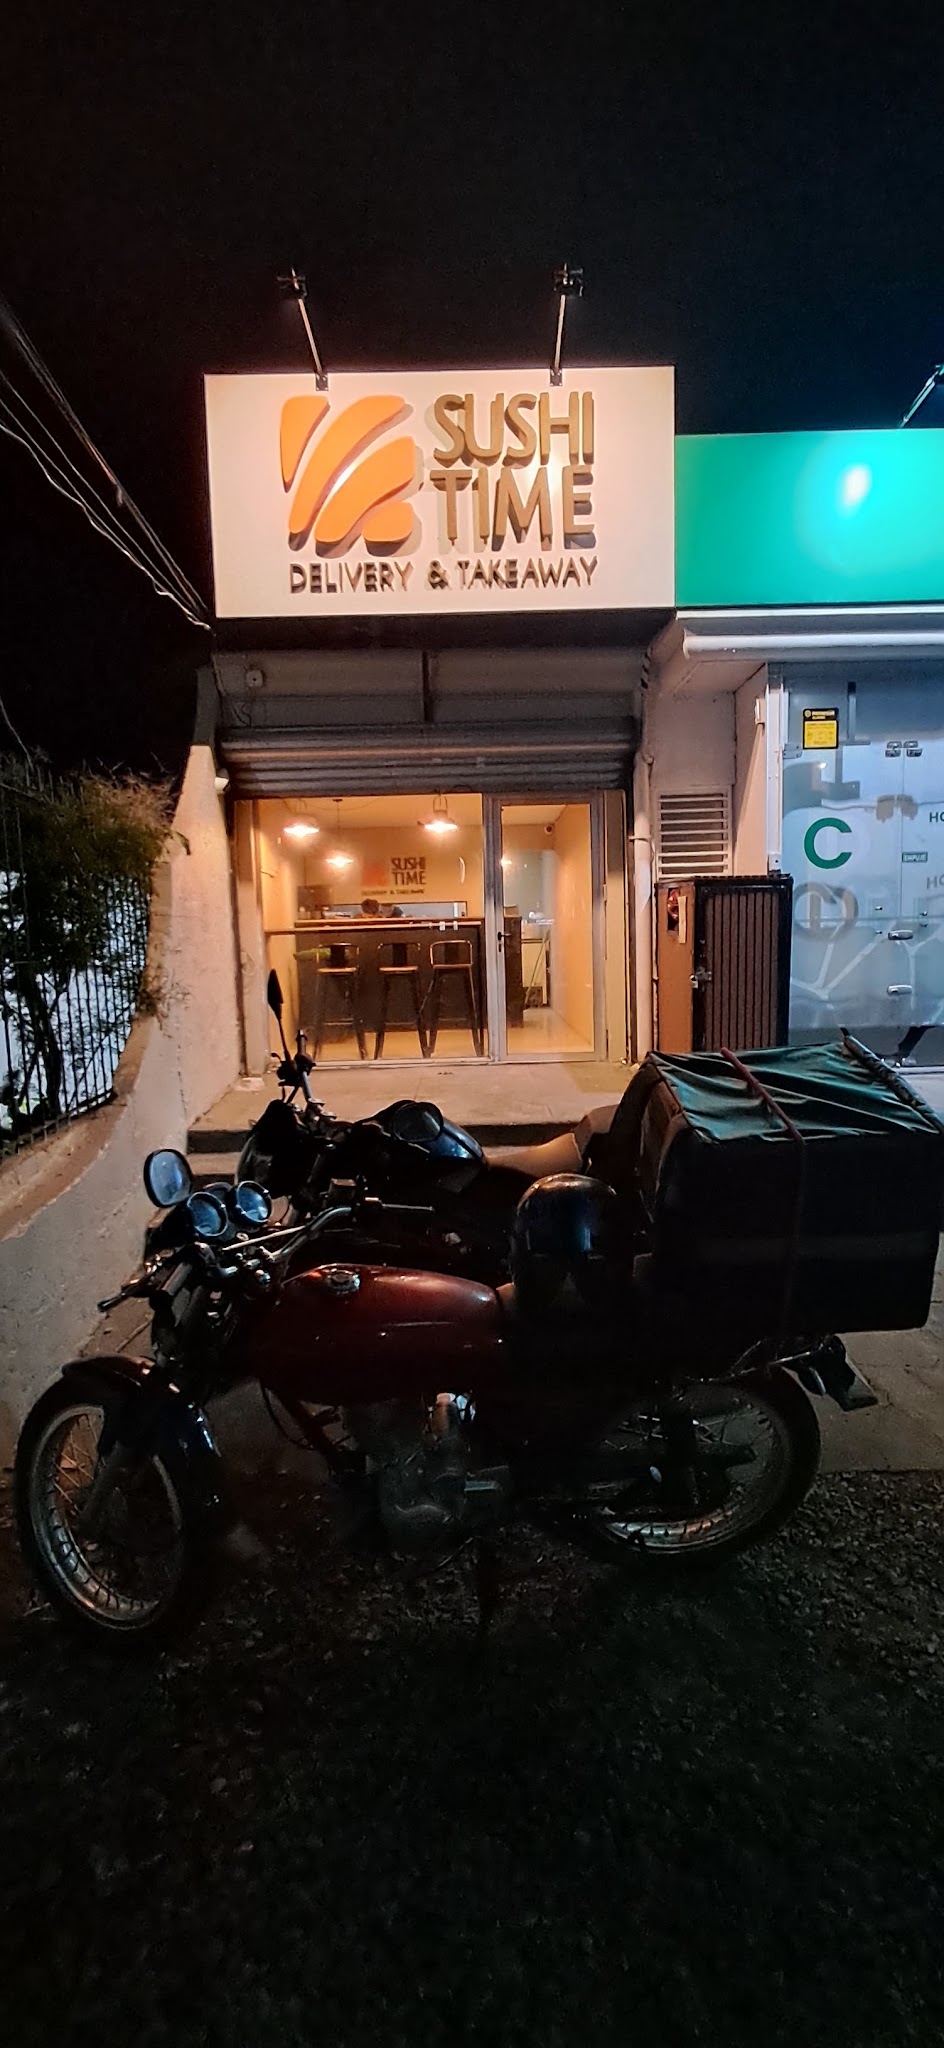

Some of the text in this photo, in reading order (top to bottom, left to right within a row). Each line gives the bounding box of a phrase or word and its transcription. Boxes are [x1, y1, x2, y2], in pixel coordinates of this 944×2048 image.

[432, 391, 595, 467] SUSHI
[430, 465, 596, 551] TIME
[289, 556, 598, 593] DELIVERY & TAKEAWAY
[391, 857, 426, 870] SUSHI
[803, 817, 852, 869] C
[392, 870, 426, 885] TIME
